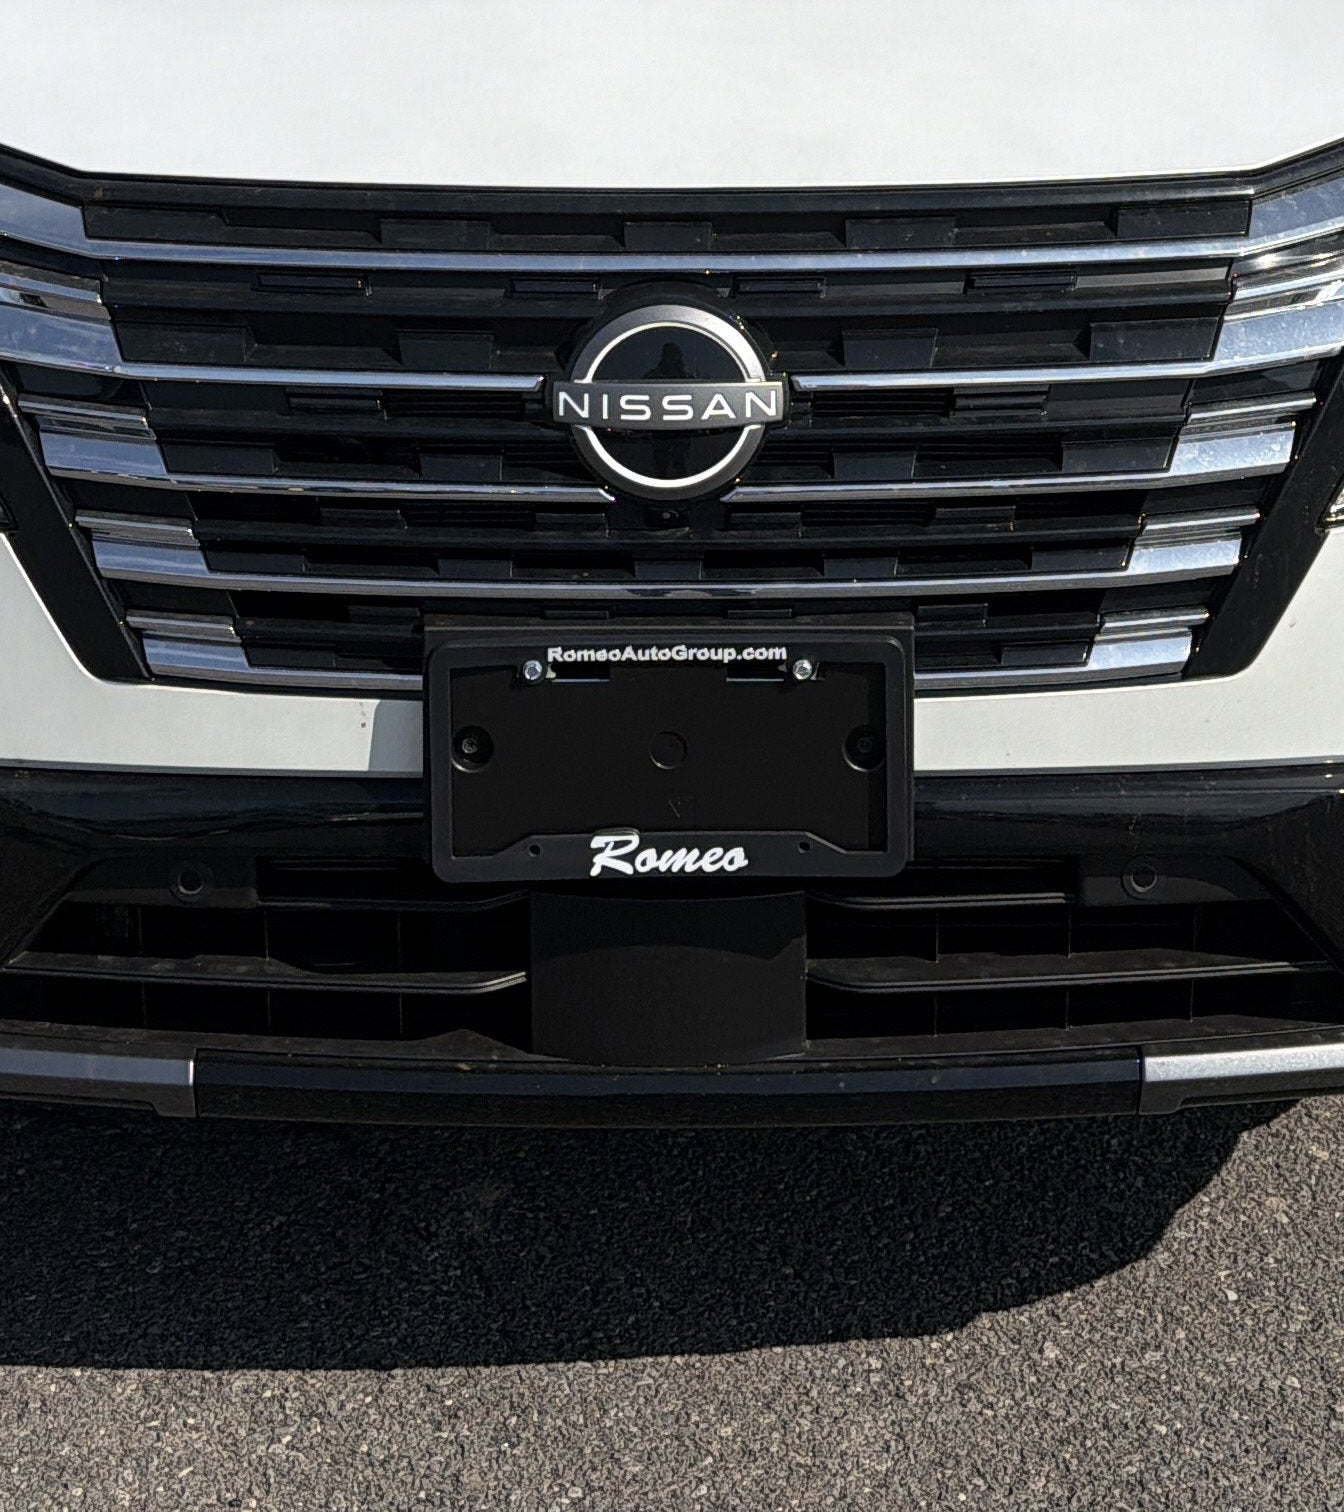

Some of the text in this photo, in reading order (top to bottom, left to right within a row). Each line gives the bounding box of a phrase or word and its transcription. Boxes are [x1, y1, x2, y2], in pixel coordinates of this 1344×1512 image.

[558, 390, 777, 421] NISSAN
[547, 645, 787, 664] RomeoAutoGroup.com
[589, 834, 749, 877] Romeo
